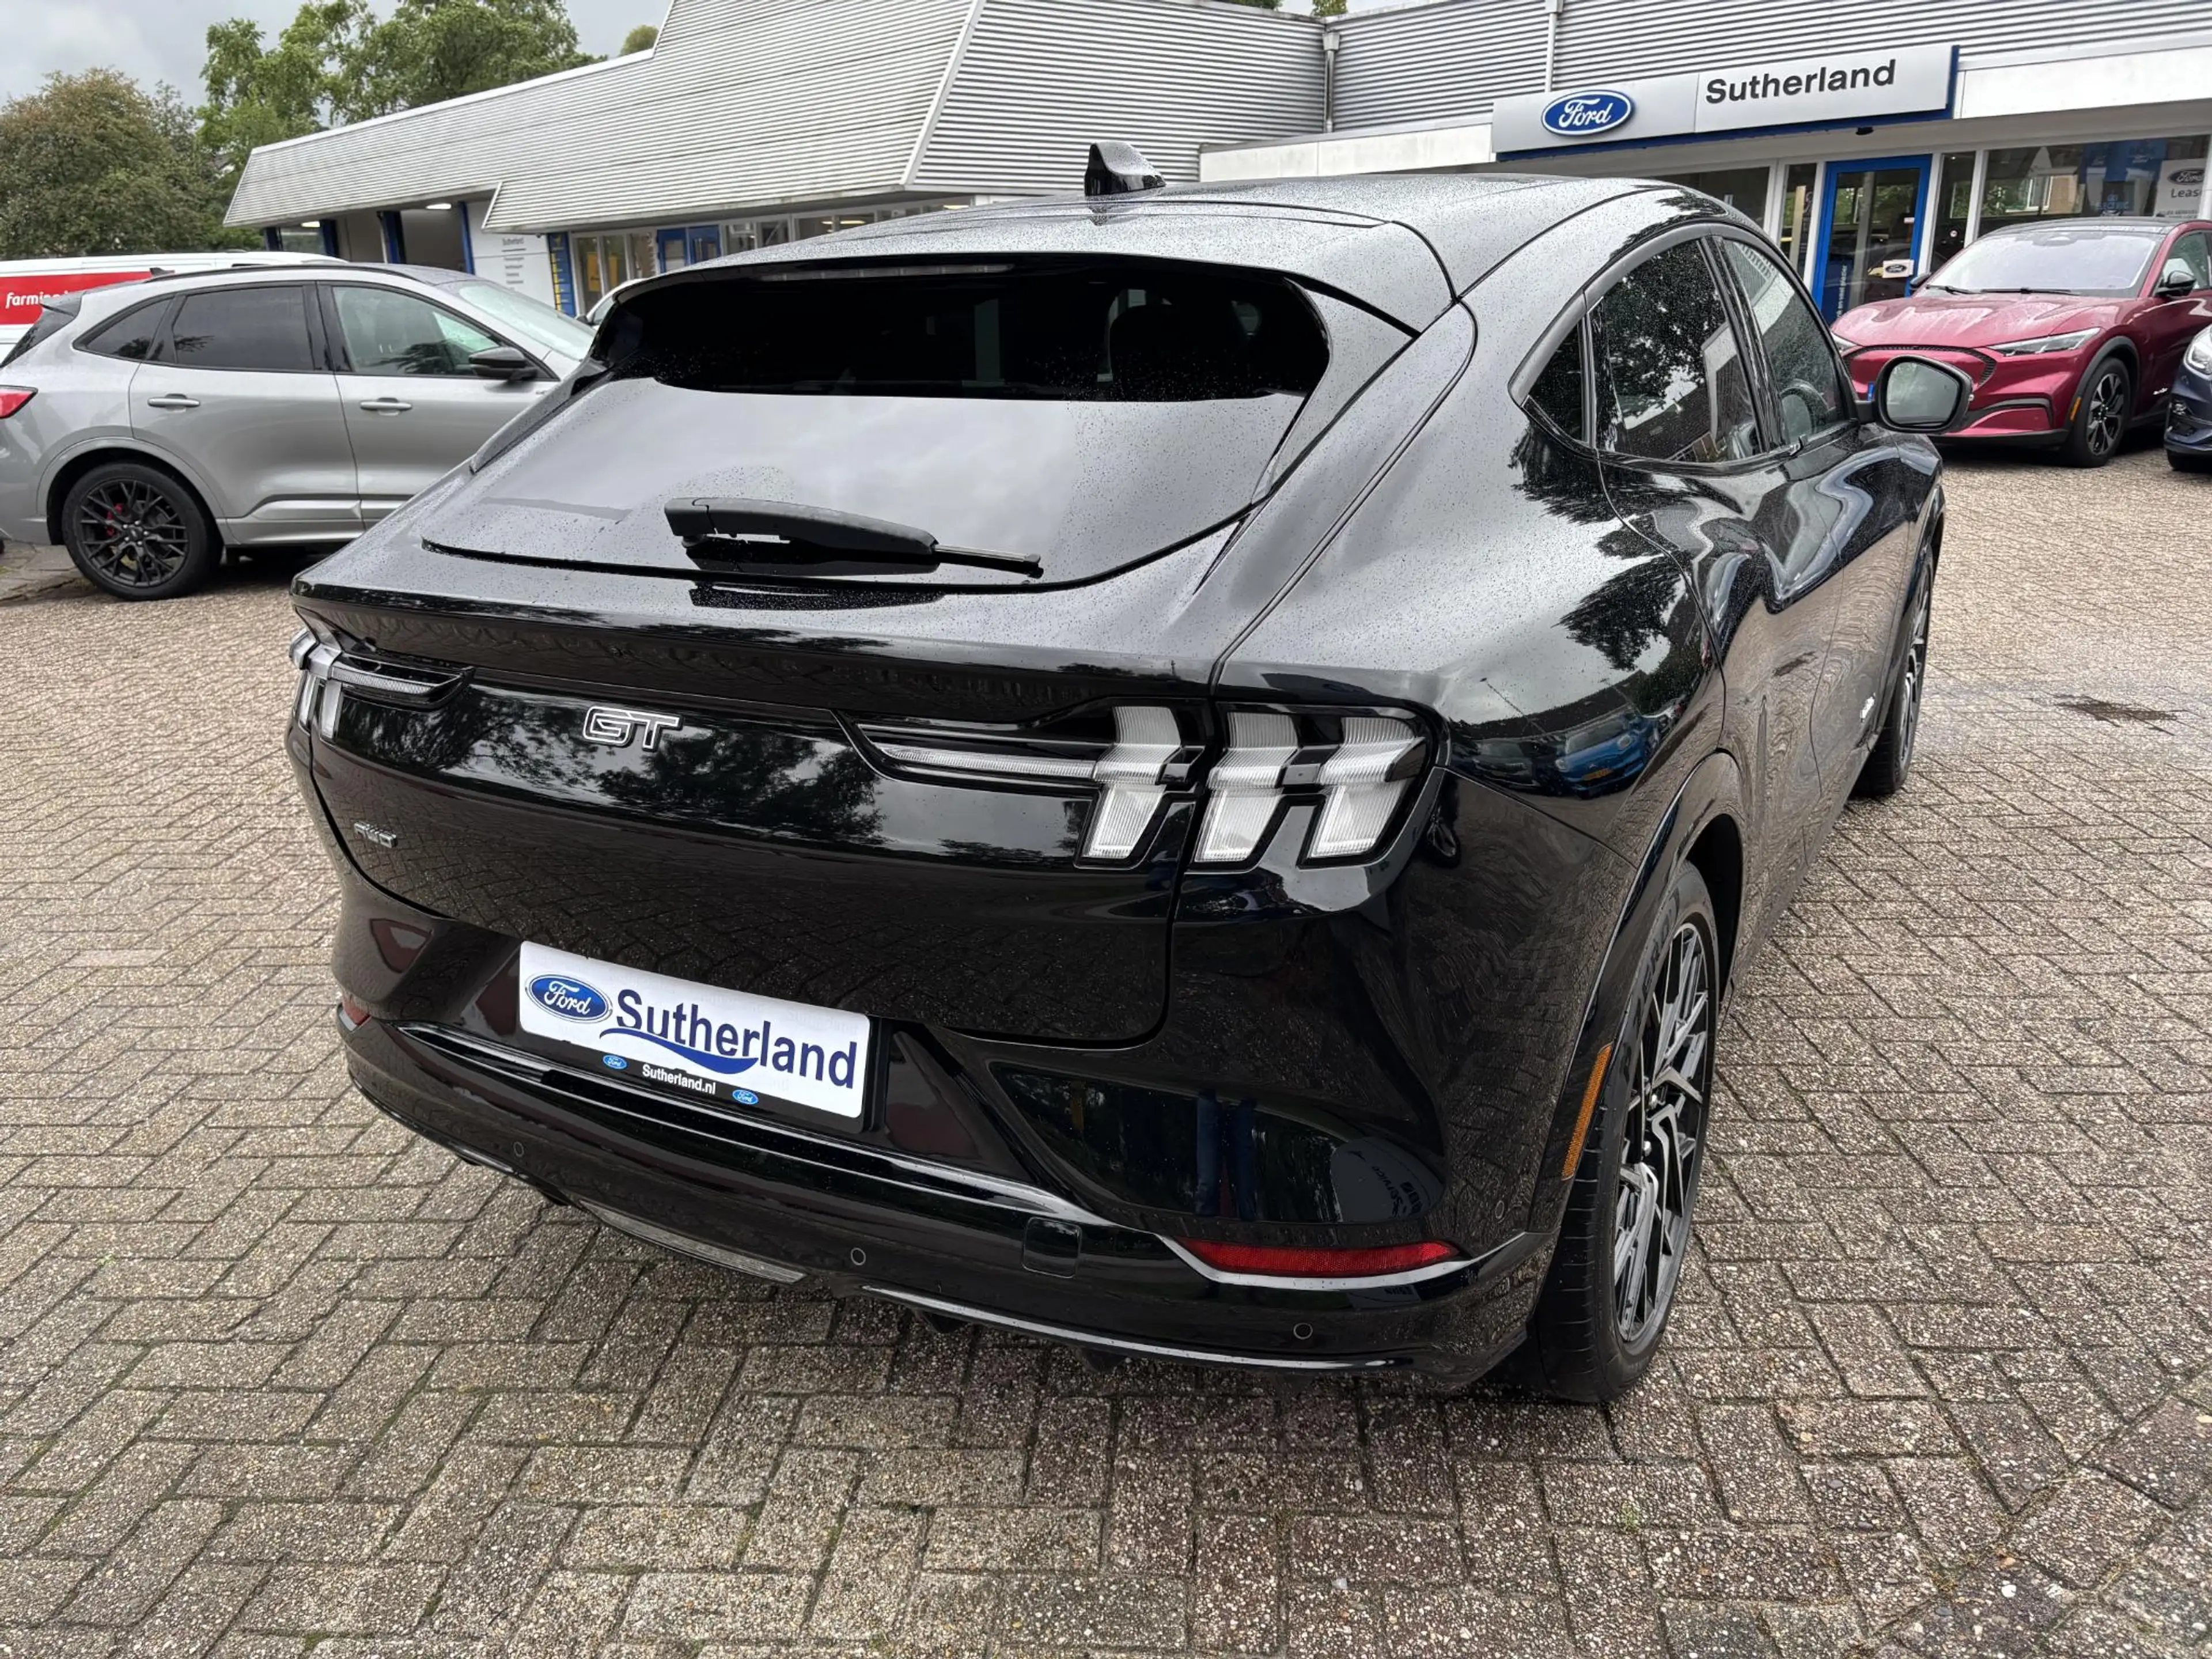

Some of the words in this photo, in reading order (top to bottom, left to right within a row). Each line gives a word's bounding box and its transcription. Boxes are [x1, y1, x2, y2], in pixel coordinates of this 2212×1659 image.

[1705, 59, 1897, 104] Sutherland
[1558, 97, 1614, 128] Ford
[2171, 188, 2202, 198] Leas
[582, 706, 681, 750] GT
[544, 980, 592, 1015] Ford
[616, 988, 858, 1089] Sutherland
[642, 1063, 717, 1095] Sutherland.nl
